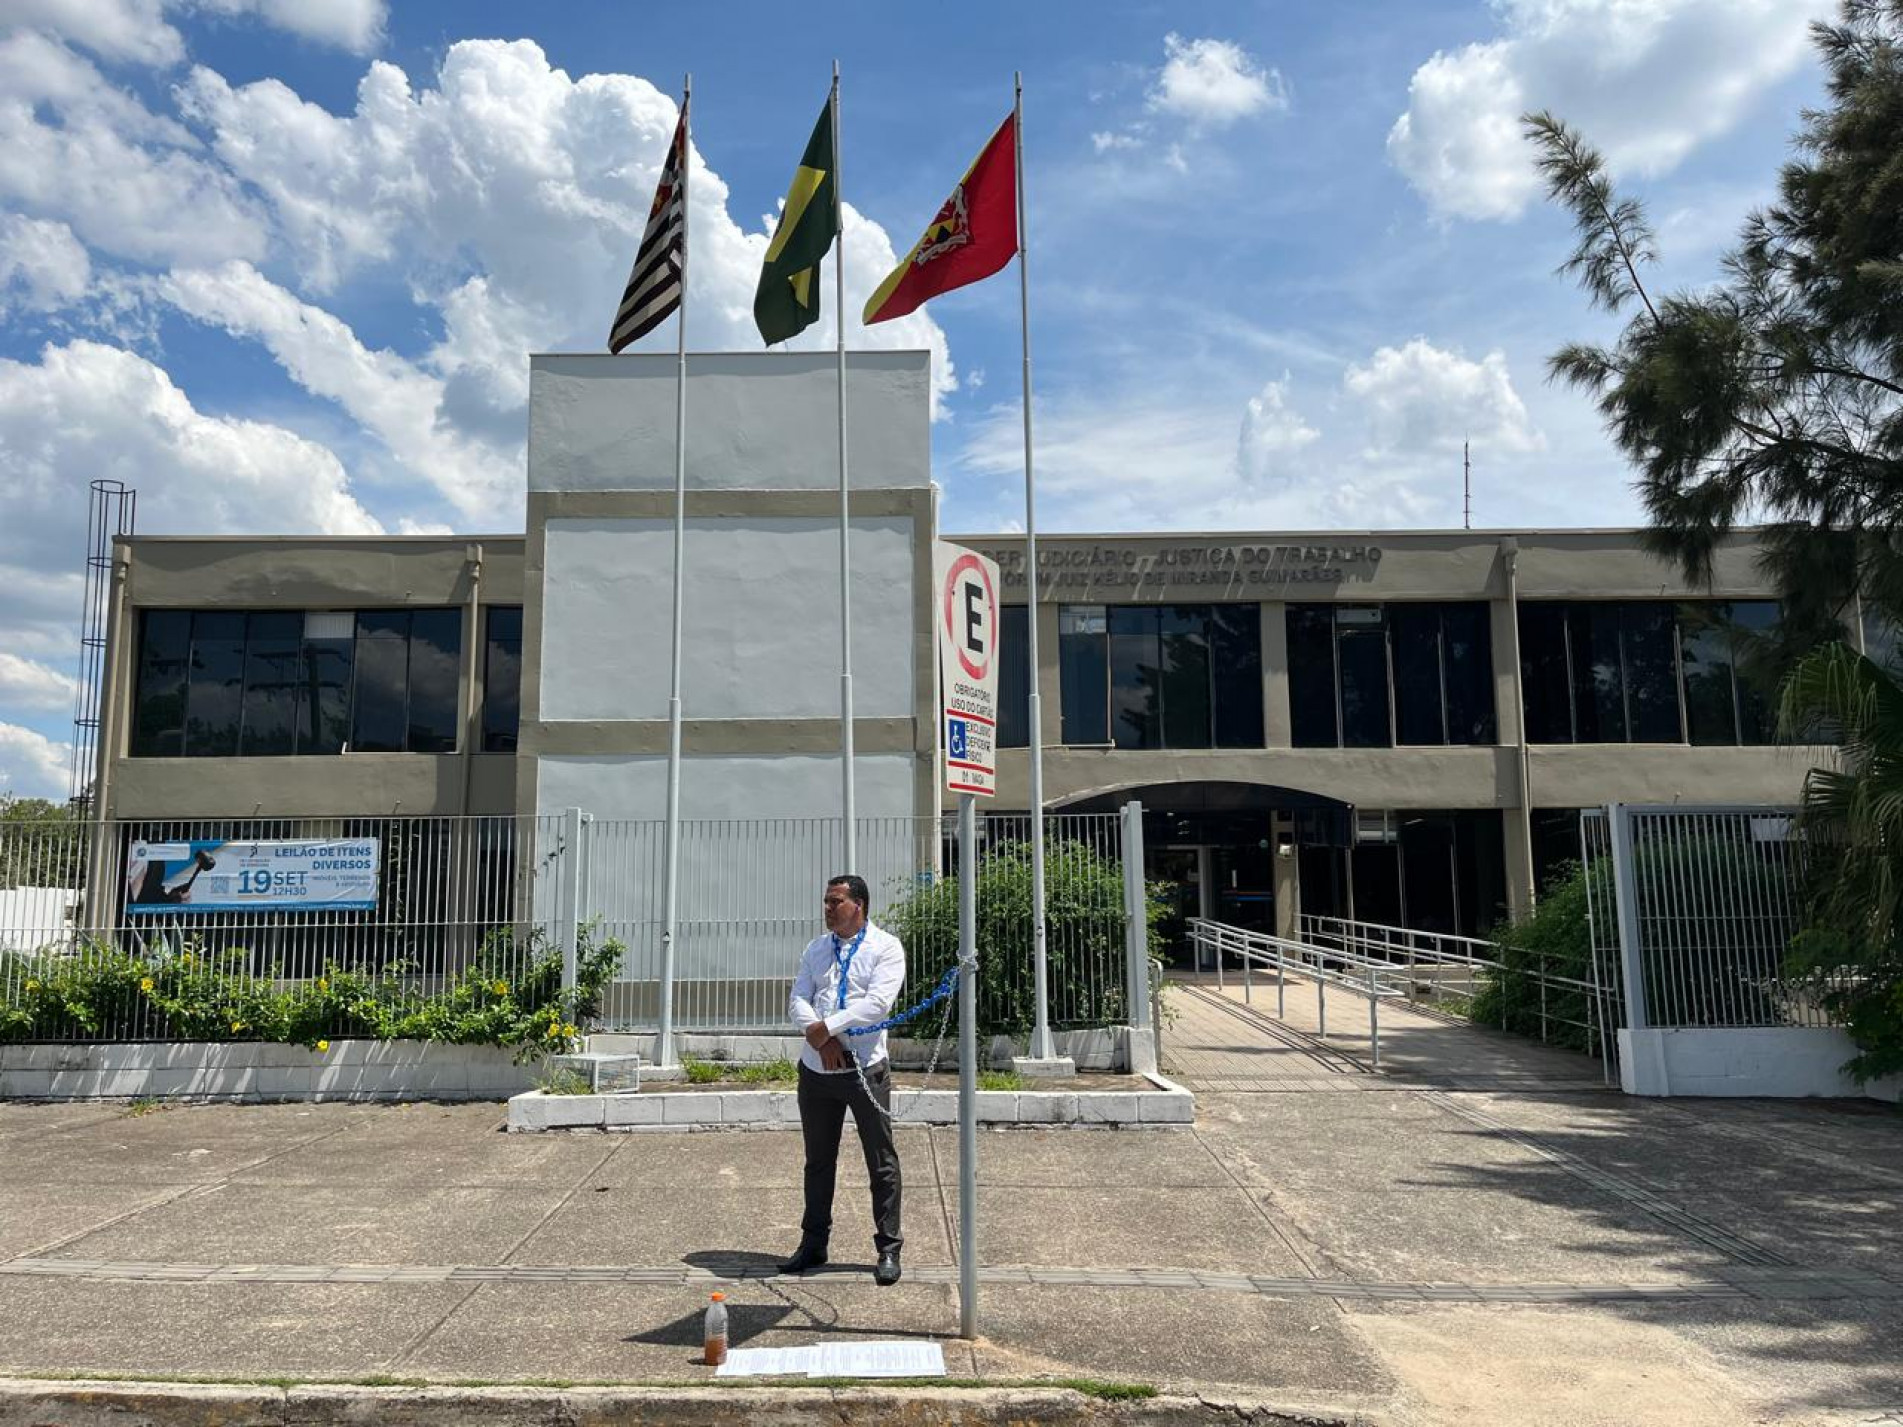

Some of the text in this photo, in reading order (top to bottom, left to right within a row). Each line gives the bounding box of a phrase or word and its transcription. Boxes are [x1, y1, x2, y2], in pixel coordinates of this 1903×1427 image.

[1036, 546, 1136, 567] UDICIÁRIO
[1156, 547, 1236, 568] JUSTIÇA
[1242, 547, 1271, 564] DO
[1276, 546, 1381, 563] TRABALHO
[965, 581, 984, 655] E
[274, 844, 372, 857] LEILÃO DE ITENS
[313, 860, 371, 870] DIVERSOS
[238, 870, 308, 894] 19 SET
[273, 887, 307, 896] 12H30
